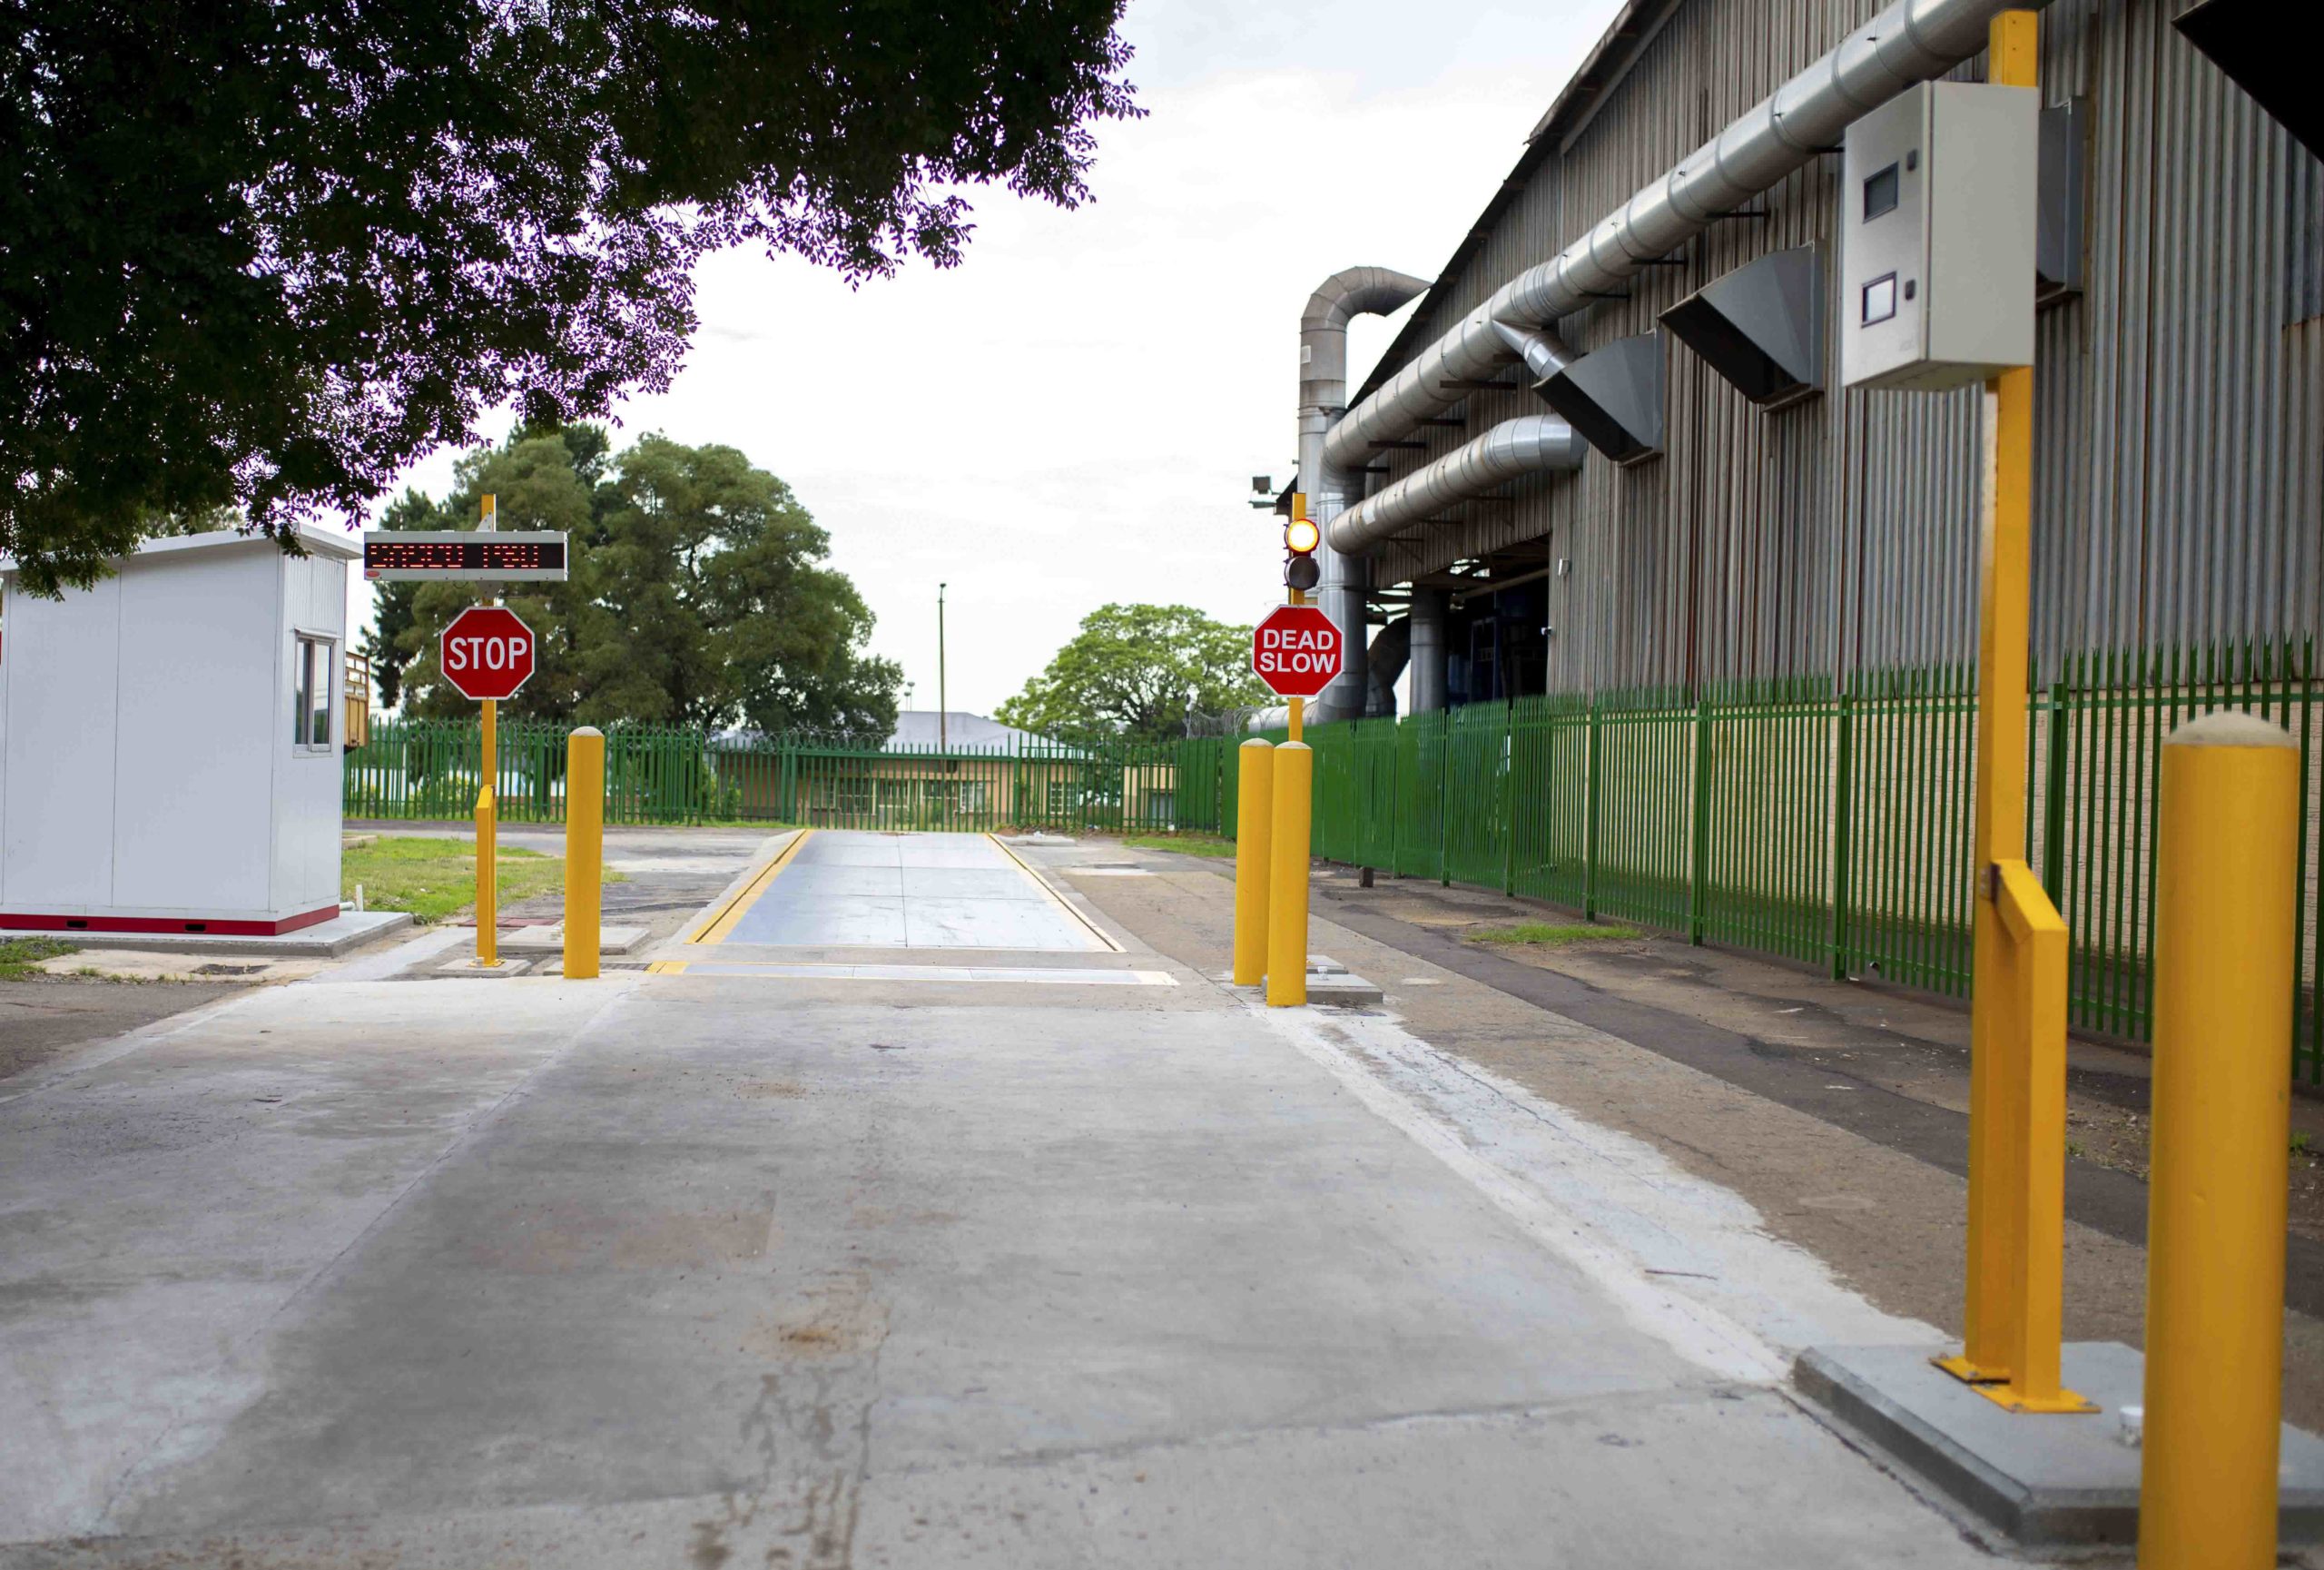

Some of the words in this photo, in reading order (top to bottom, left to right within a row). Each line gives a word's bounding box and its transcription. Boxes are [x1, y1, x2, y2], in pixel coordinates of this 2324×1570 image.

[1263, 628, 1334, 650] DEAD
[448, 637, 528, 670] STOP
[1259, 651, 1337, 674] SLOW
